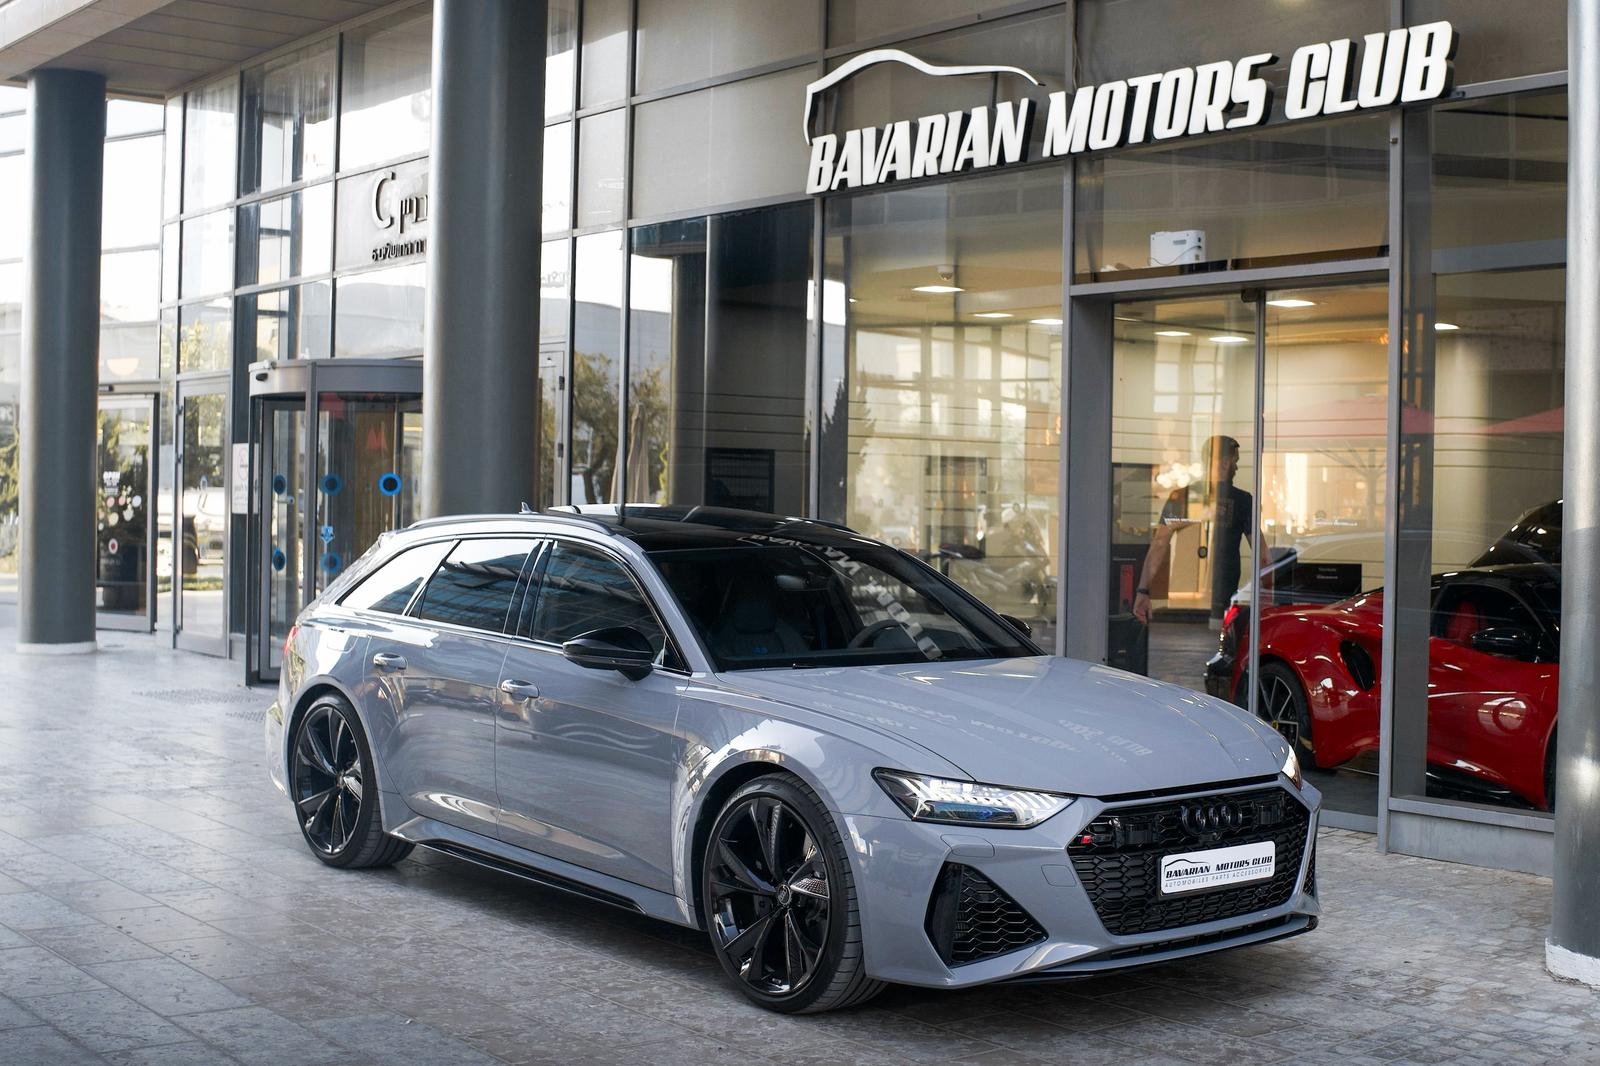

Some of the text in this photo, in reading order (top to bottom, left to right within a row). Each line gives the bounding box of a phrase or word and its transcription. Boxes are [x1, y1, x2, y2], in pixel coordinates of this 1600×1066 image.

[806, 21, 1454, 195] BAVARIAN MOTORS CLUB
[373, 171, 396, 230] C
[1165, 877, 1209, 888] AUTOMOBILES
[1212, 873, 1230, 881] PARTS
[1166, 855, 1273, 878] BAVARIAN MOTORS CLUB
